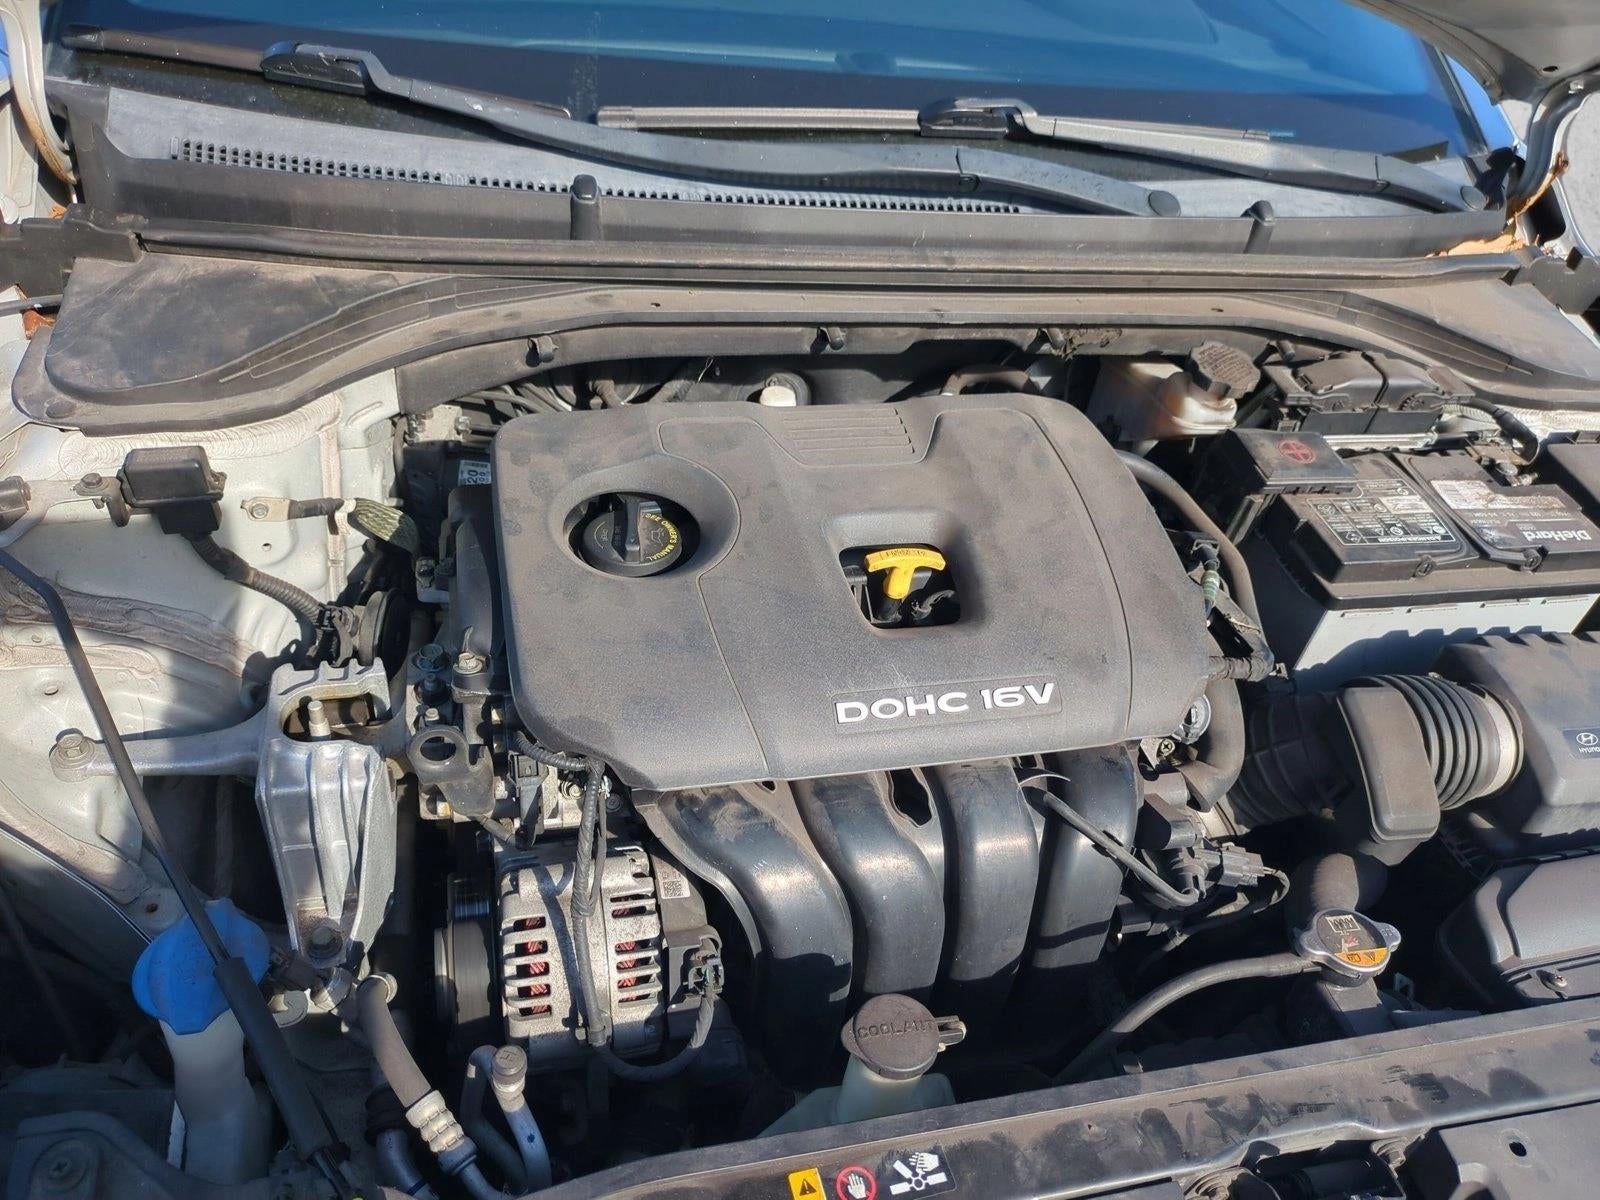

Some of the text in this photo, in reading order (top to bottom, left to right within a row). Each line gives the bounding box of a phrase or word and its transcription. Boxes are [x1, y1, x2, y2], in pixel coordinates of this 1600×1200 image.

[1523, 530, 1592, 541] DieHard
[646, 544, 675, 561] MANUAL
[835, 683, 1055, 724] DOHC 16V
